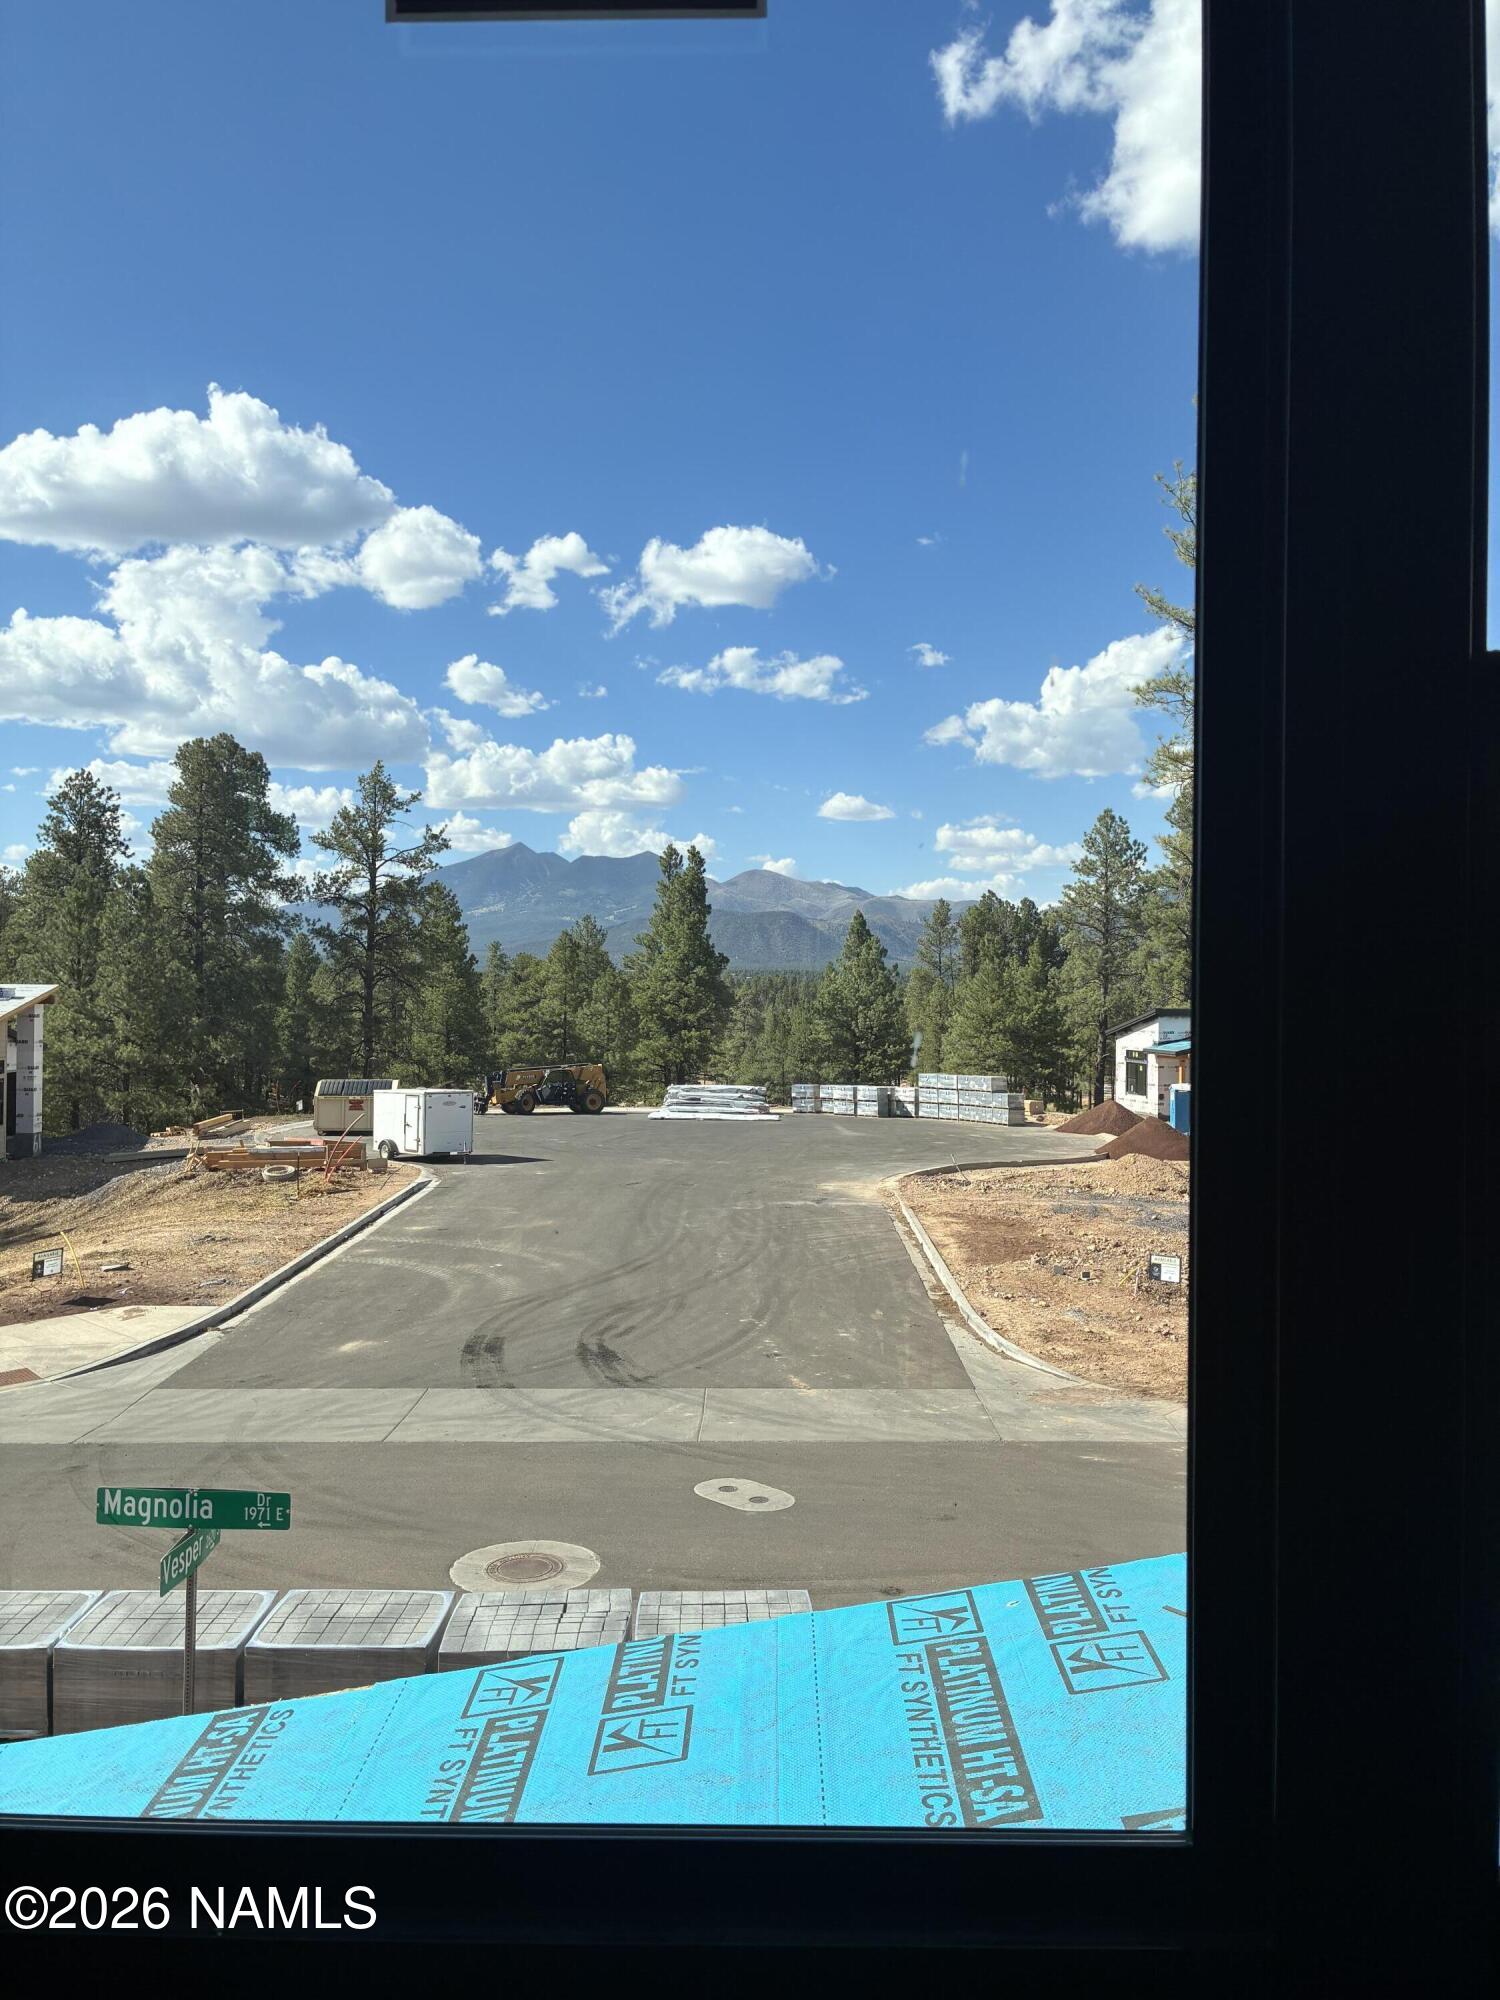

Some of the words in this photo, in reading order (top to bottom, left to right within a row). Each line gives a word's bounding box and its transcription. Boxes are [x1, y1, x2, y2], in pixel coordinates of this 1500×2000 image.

[103, 1488, 213, 1526] Magnolia
[257, 1493, 272, 1507] Dr
[244, 1506, 271, 1521] 1971
[276, 1506, 284, 1521] E
[162, 1534, 204, 1585] Vesper
[1103, 1604, 1138, 1624] FT
[895, 1652, 925, 1675] FT
[671, 1675, 696, 1697] FT
[935, 1640, 1009, 1747] PLATINUM
[447, 1728, 478, 1751] FT
[901, 1680, 957, 1827] SYNTHETICS
[960, 1747, 1030, 1823] HT-SA
